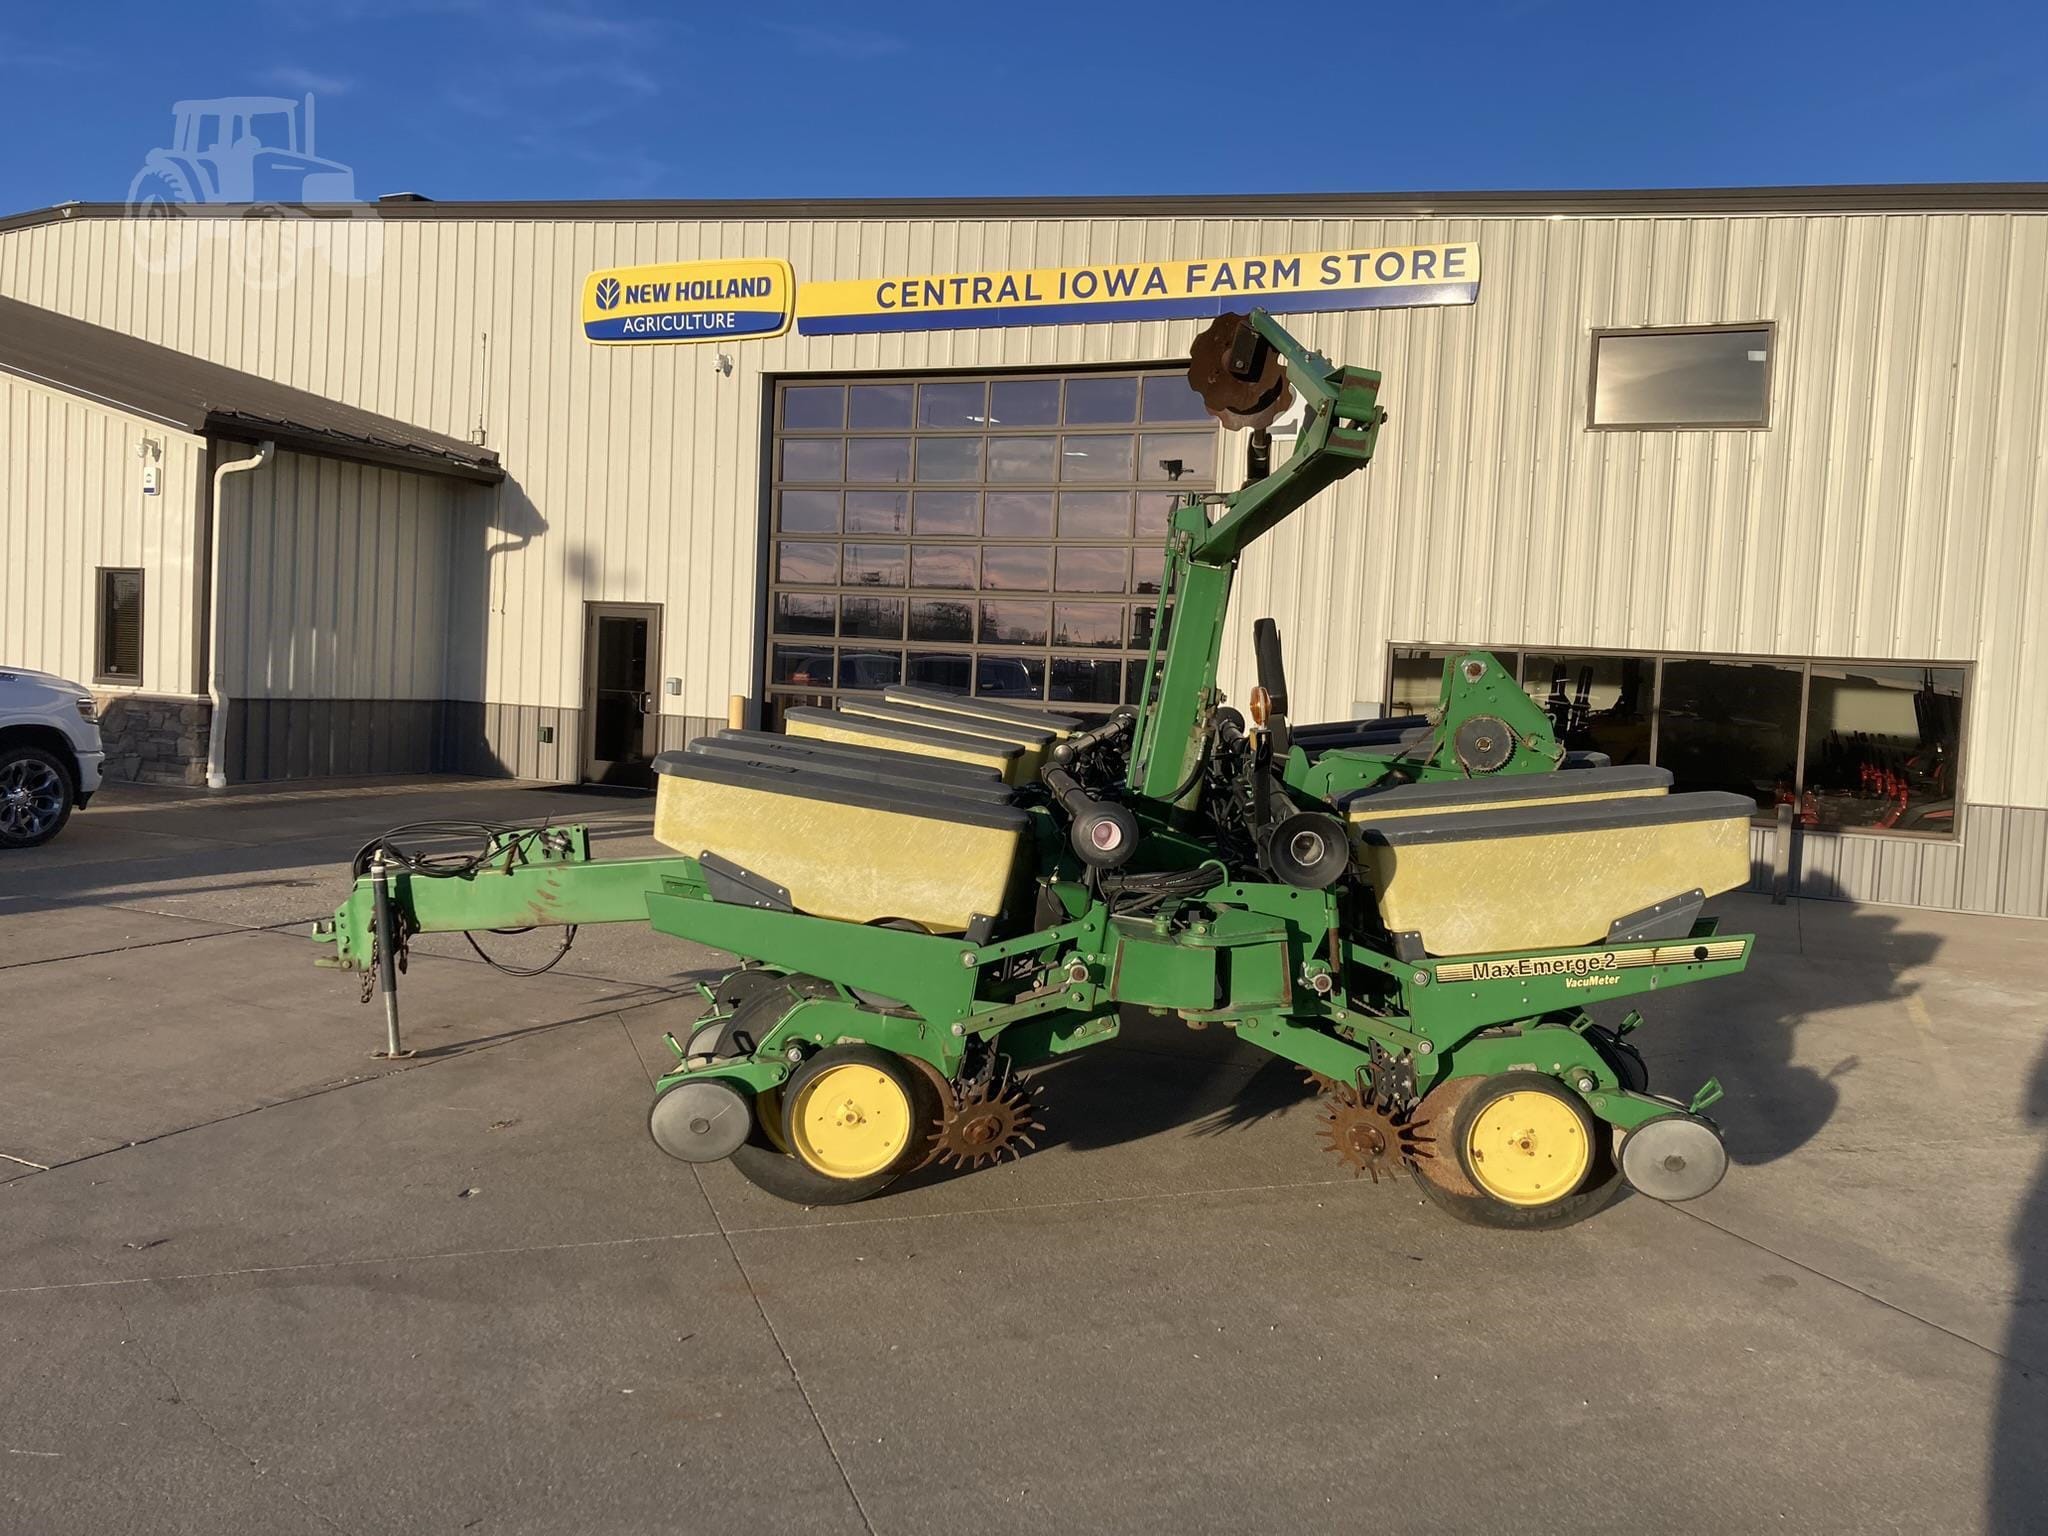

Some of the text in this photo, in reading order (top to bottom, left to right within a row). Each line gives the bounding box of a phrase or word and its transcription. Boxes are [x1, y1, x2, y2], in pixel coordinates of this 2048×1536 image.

[875, 247, 1467, 308] CENTRAL IOWA FARM STORE
[625, 276, 772, 305] NEW HOLLAND
[622, 312, 736, 333] AGRICULTURE
[1565, 974, 1621, 988] VacuMeter
